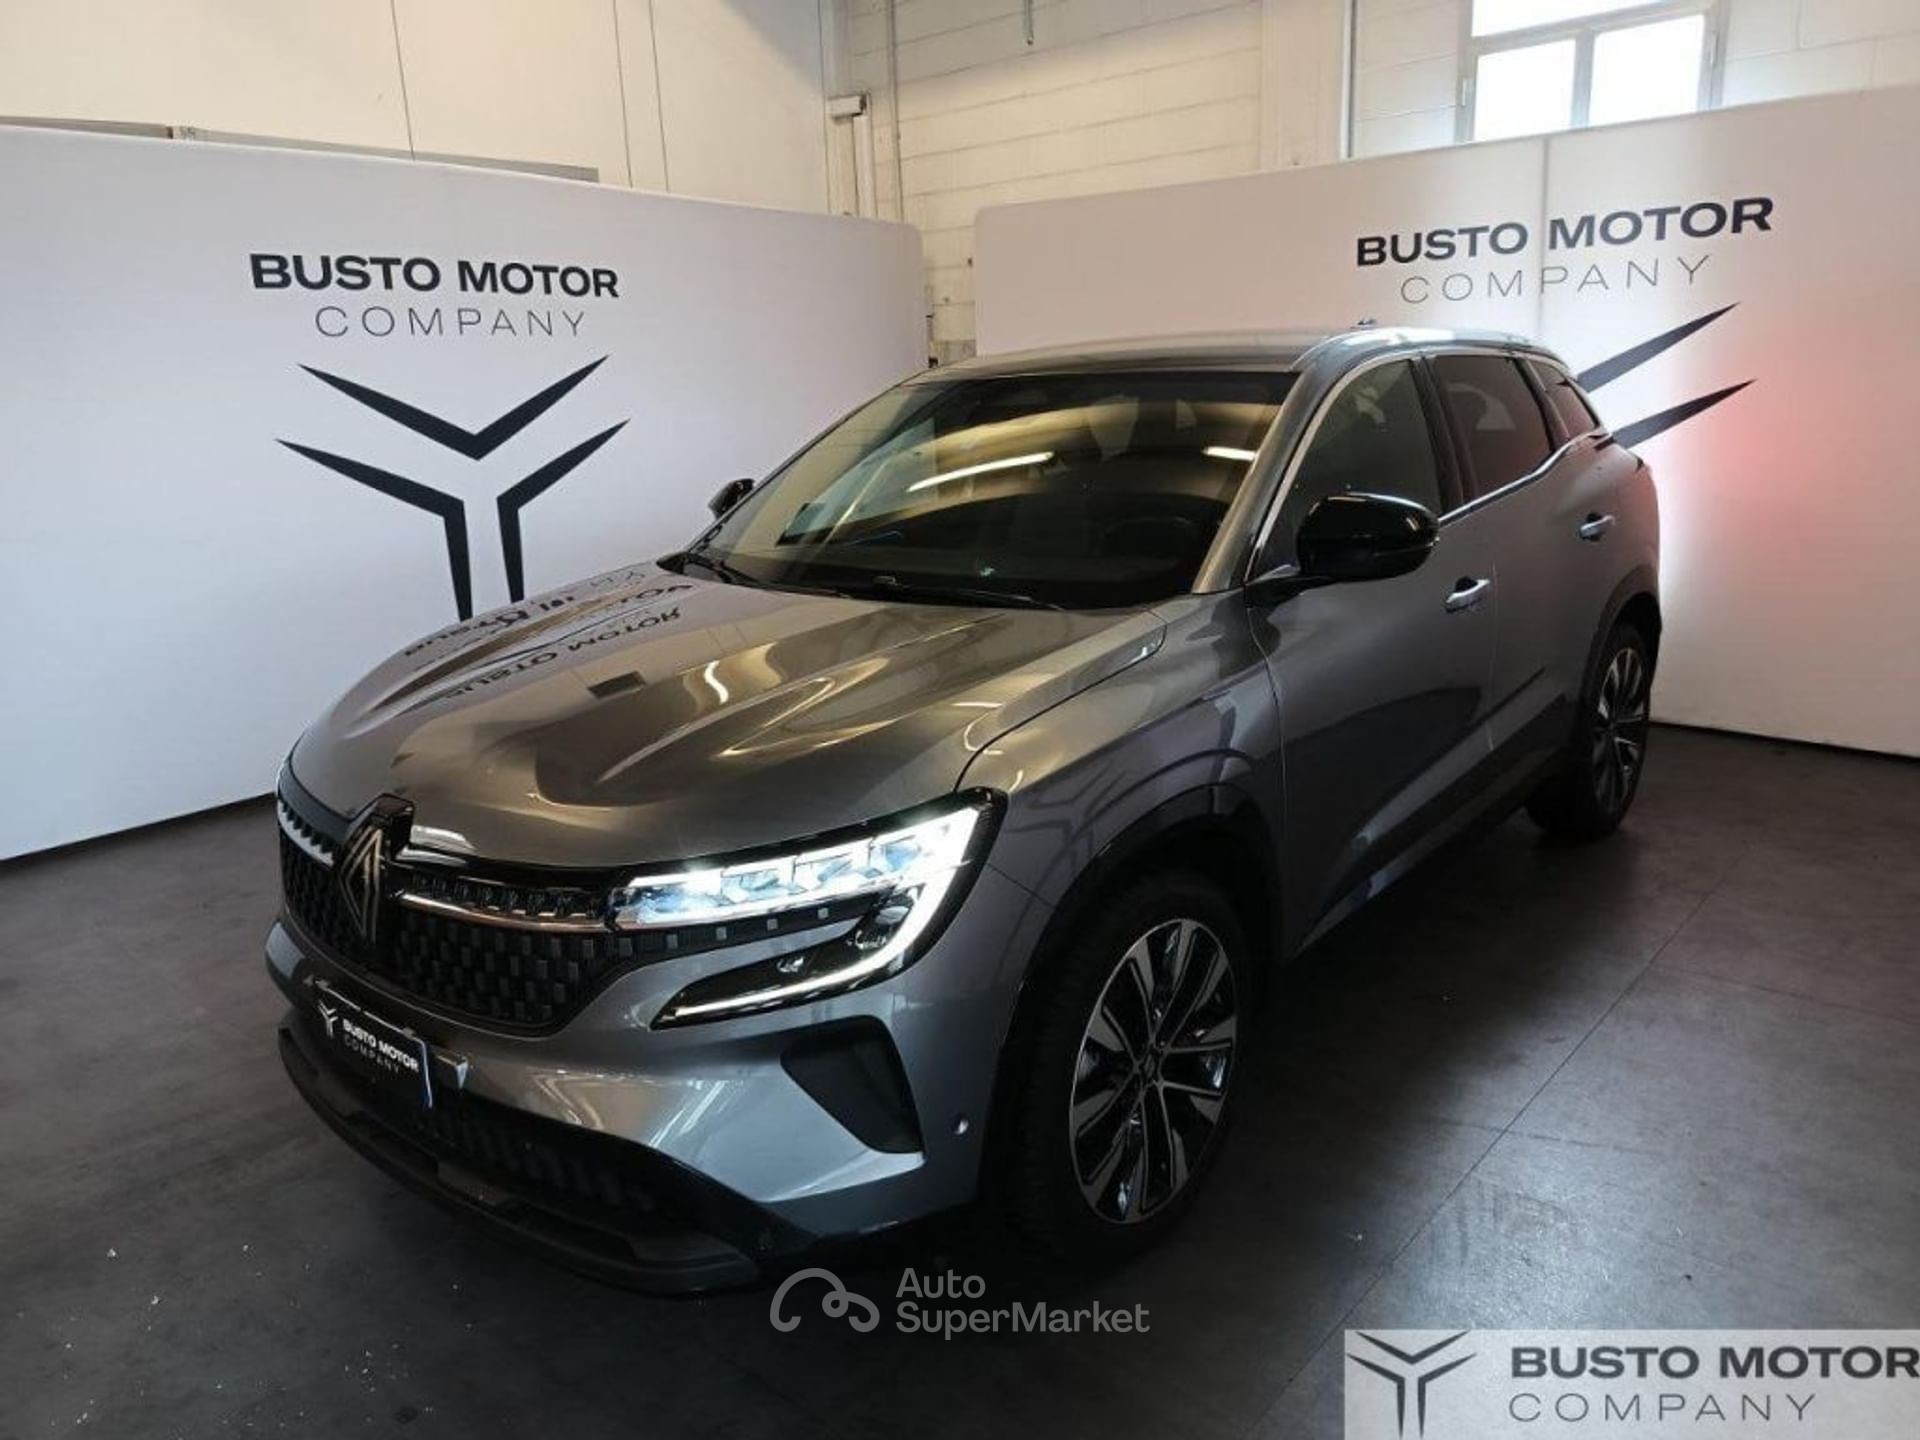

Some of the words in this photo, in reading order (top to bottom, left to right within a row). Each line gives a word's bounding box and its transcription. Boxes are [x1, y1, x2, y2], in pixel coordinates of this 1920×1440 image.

[1356, 221, 1528, 266] BUSTO
[1549, 196, 1774, 250] MOTOR
[249, 253, 441, 292] BUSTO
[457, 260, 620, 298] MOTOR
[1400, 254, 1711, 304] COMPANY
[315, 305, 586, 337] COMPANY
[343, 1018, 377, 1048] BUSTO
[378, 1040, 419, 1072] MOTOR
[345, 1034, 400, 1073] COMPANY
